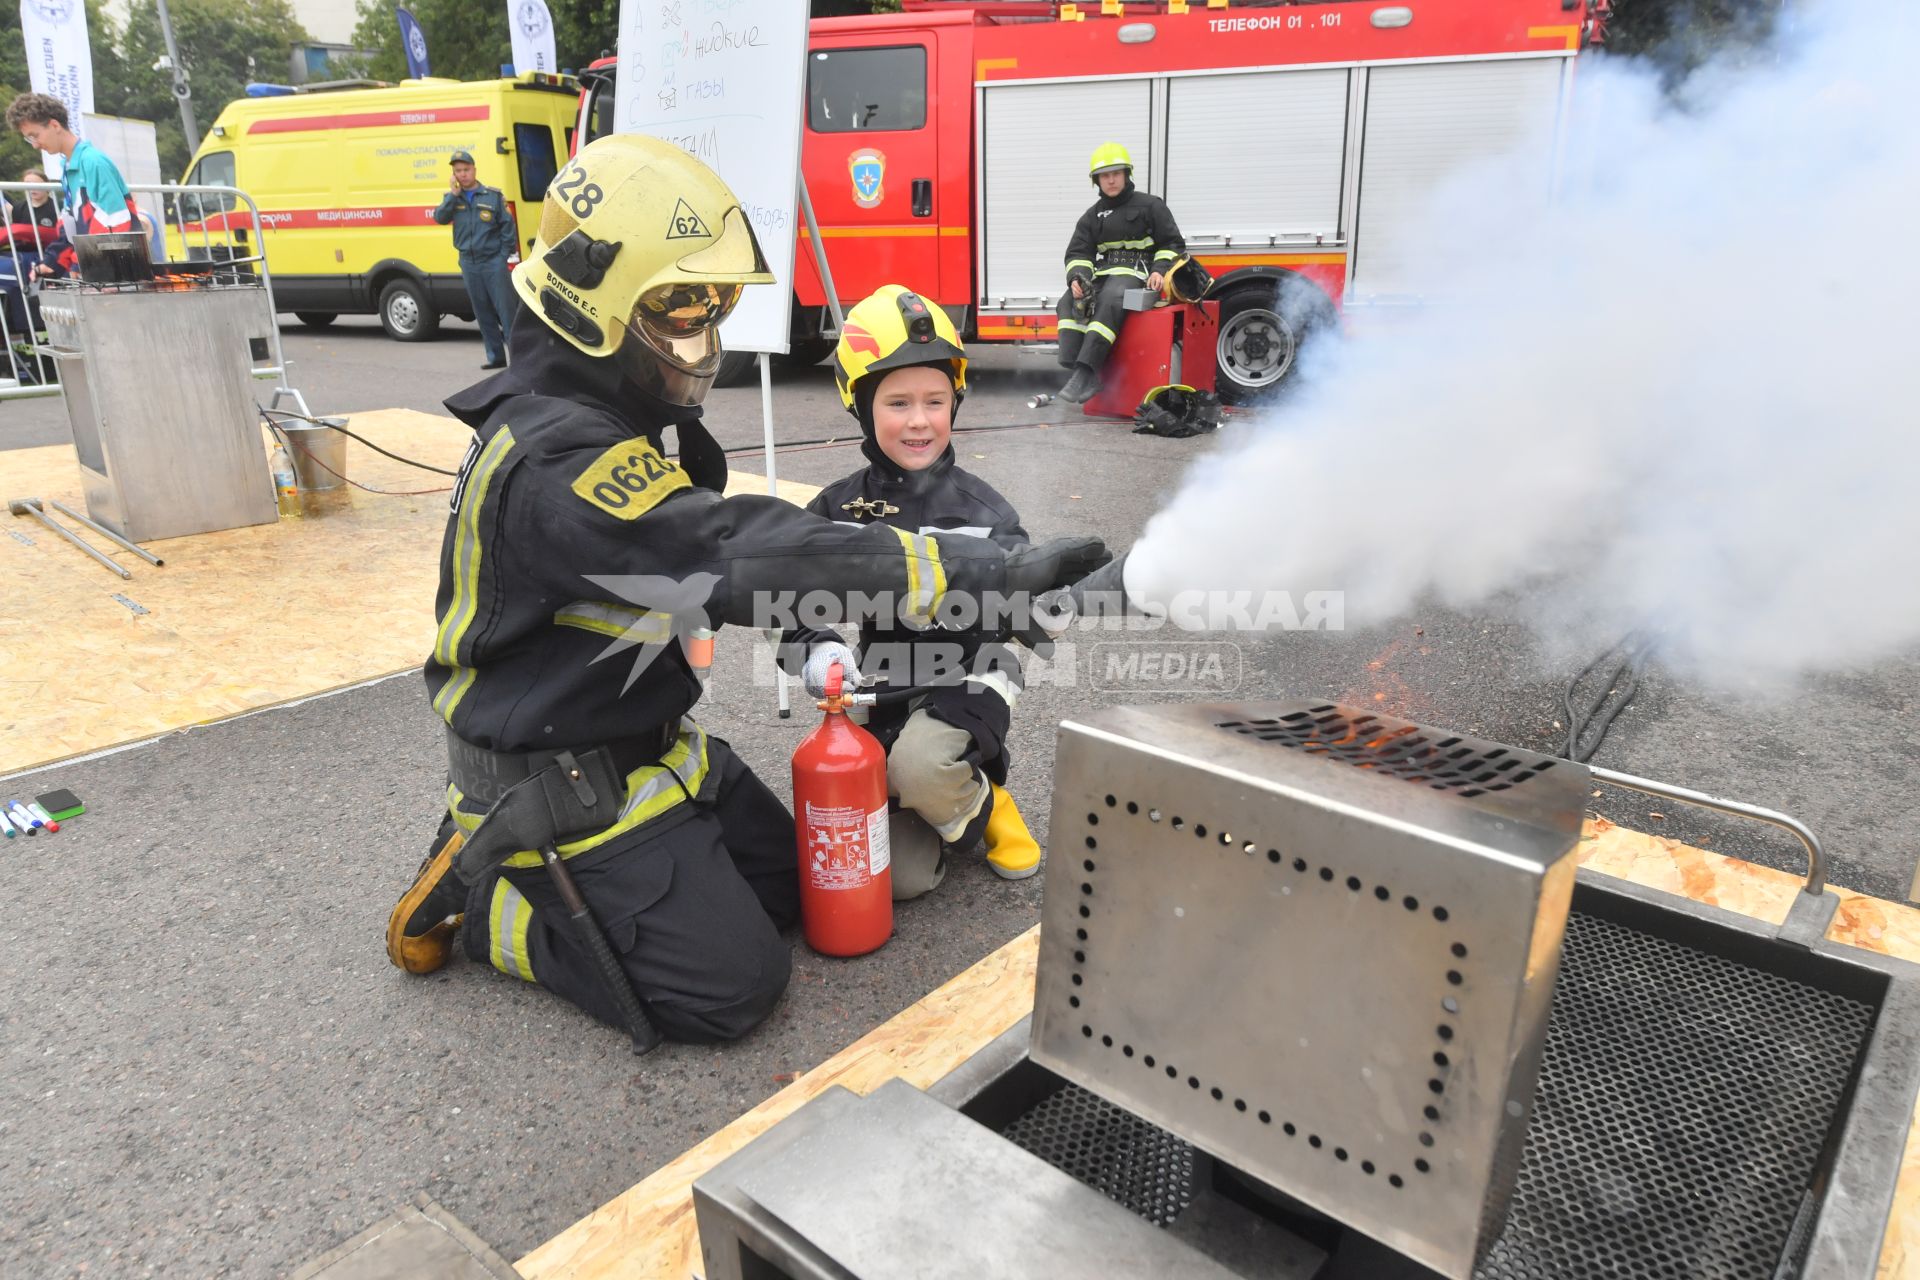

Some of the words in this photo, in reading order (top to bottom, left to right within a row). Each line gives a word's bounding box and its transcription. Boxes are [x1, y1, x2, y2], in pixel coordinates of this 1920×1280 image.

[1209, 16, 1281, 33] ТЕЛЕФОН
[1287, 15, 1302, 29] 01
[1320, 12, 1341, 27] 101
[260, 213, 292, 223] СКОРАЯ
[317, 209, 383, 221] МЕДИЦИНСКАЯ
[676, 216, 700, 235] 62
[546, 272, 580, 304] ВОЛКОВ
[581, 300, 599, 318] Е.С.
